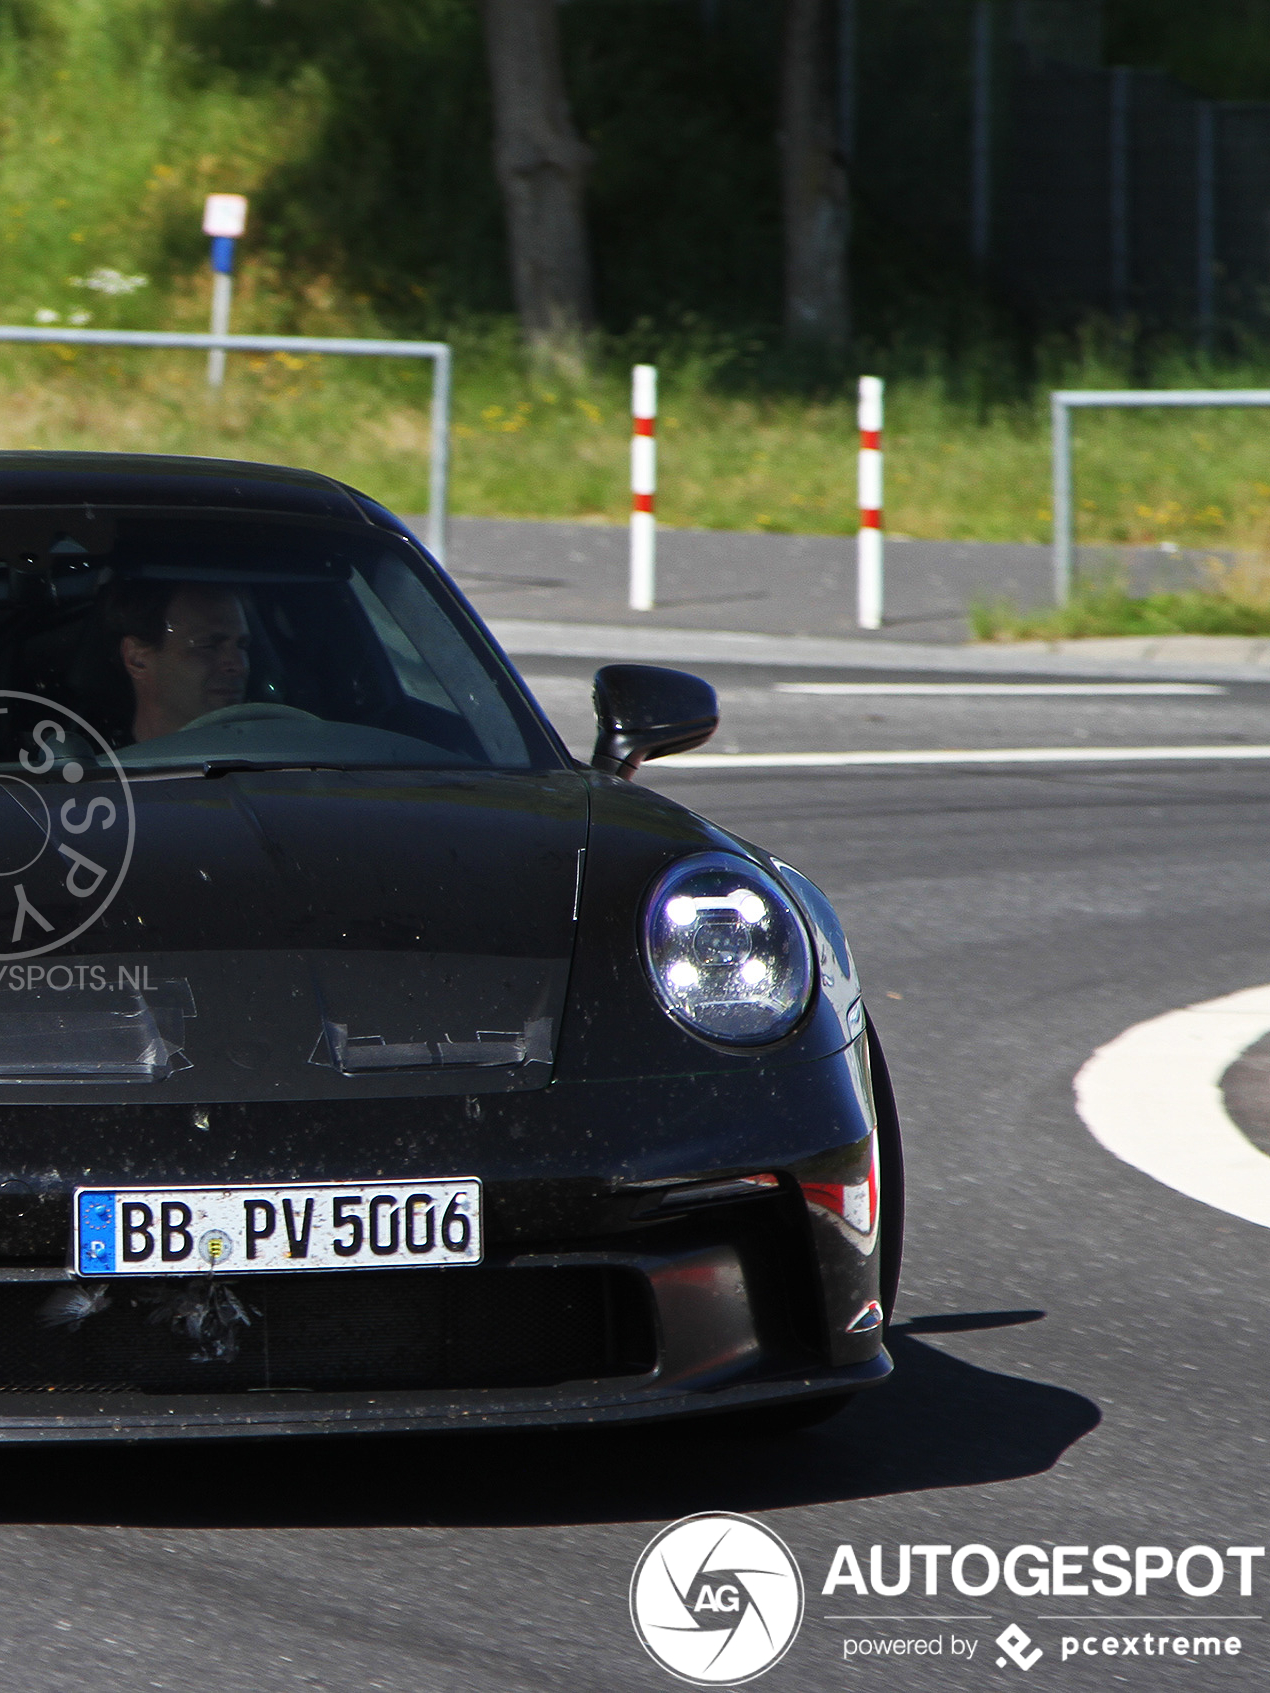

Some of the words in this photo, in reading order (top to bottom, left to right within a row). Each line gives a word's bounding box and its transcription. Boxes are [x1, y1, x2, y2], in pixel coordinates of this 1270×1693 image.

[122, 1201, 193, 1262] BB
[244, 1197, 314, 1260] PV
[332, 1192, 472, 1257] 5006
